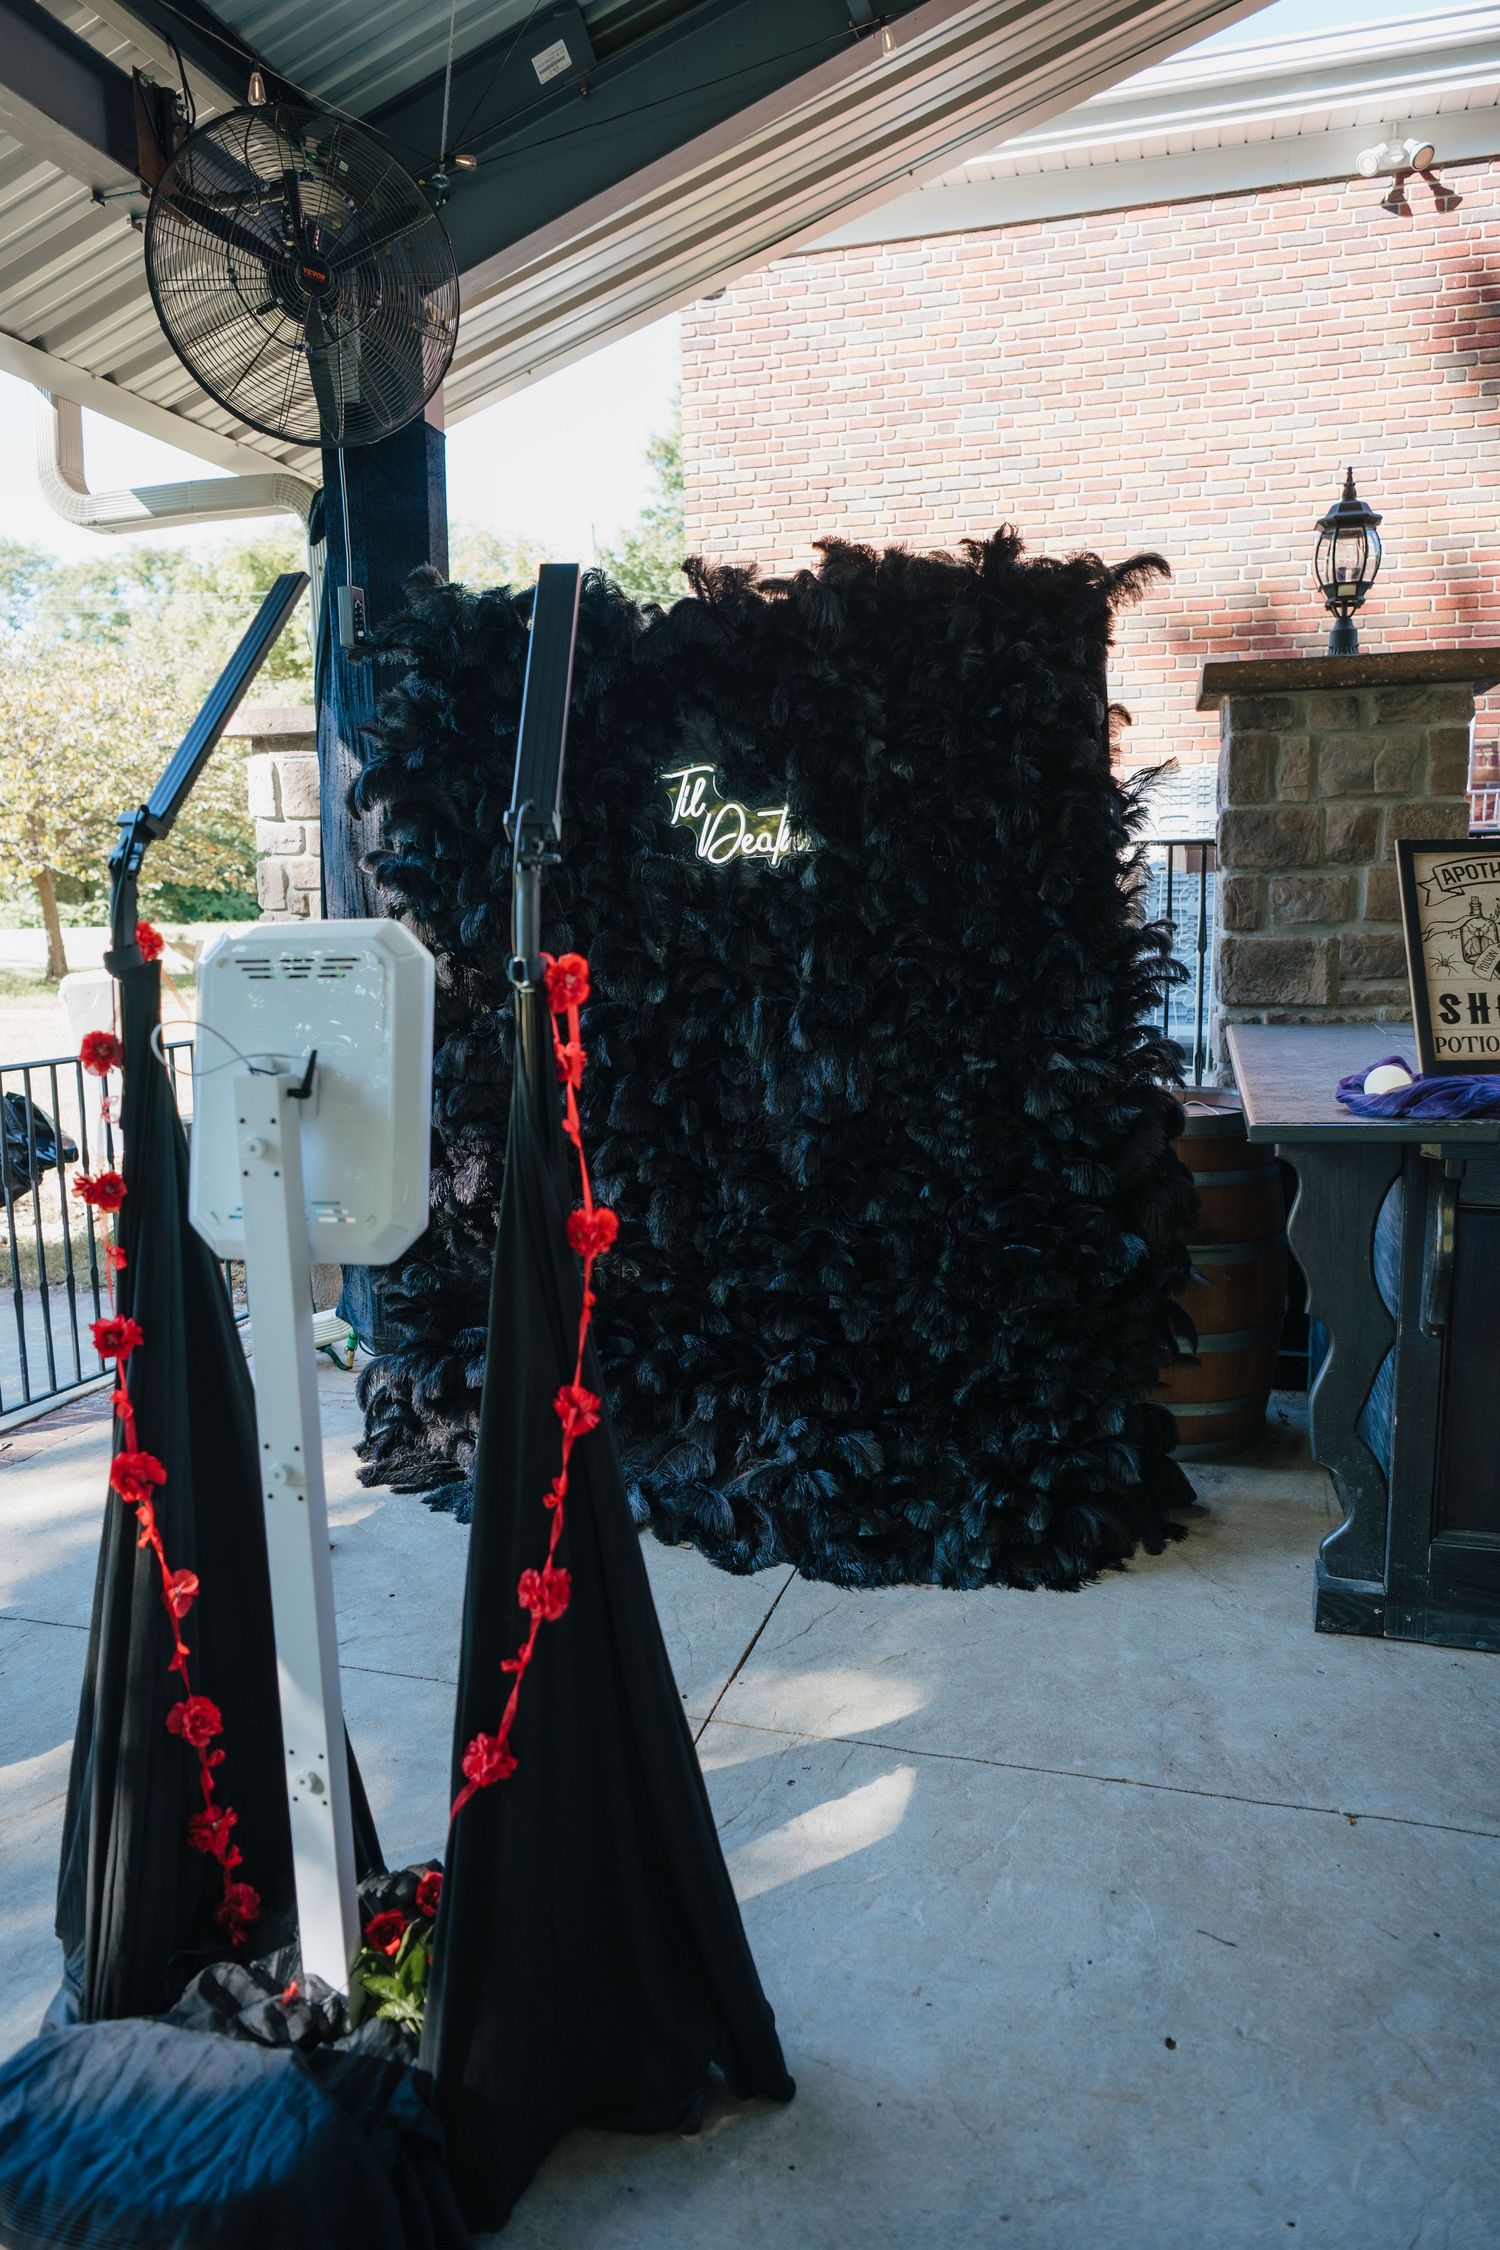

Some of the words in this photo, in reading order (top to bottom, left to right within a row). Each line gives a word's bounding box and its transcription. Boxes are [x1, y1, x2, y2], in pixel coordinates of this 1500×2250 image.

[660, 765, 714, 825] Til
[1475, 950, 1498, 973] POISON
[1437, 992, 1500, 1025] SH
[1434, 1035, 1500, 1054] POTIO
